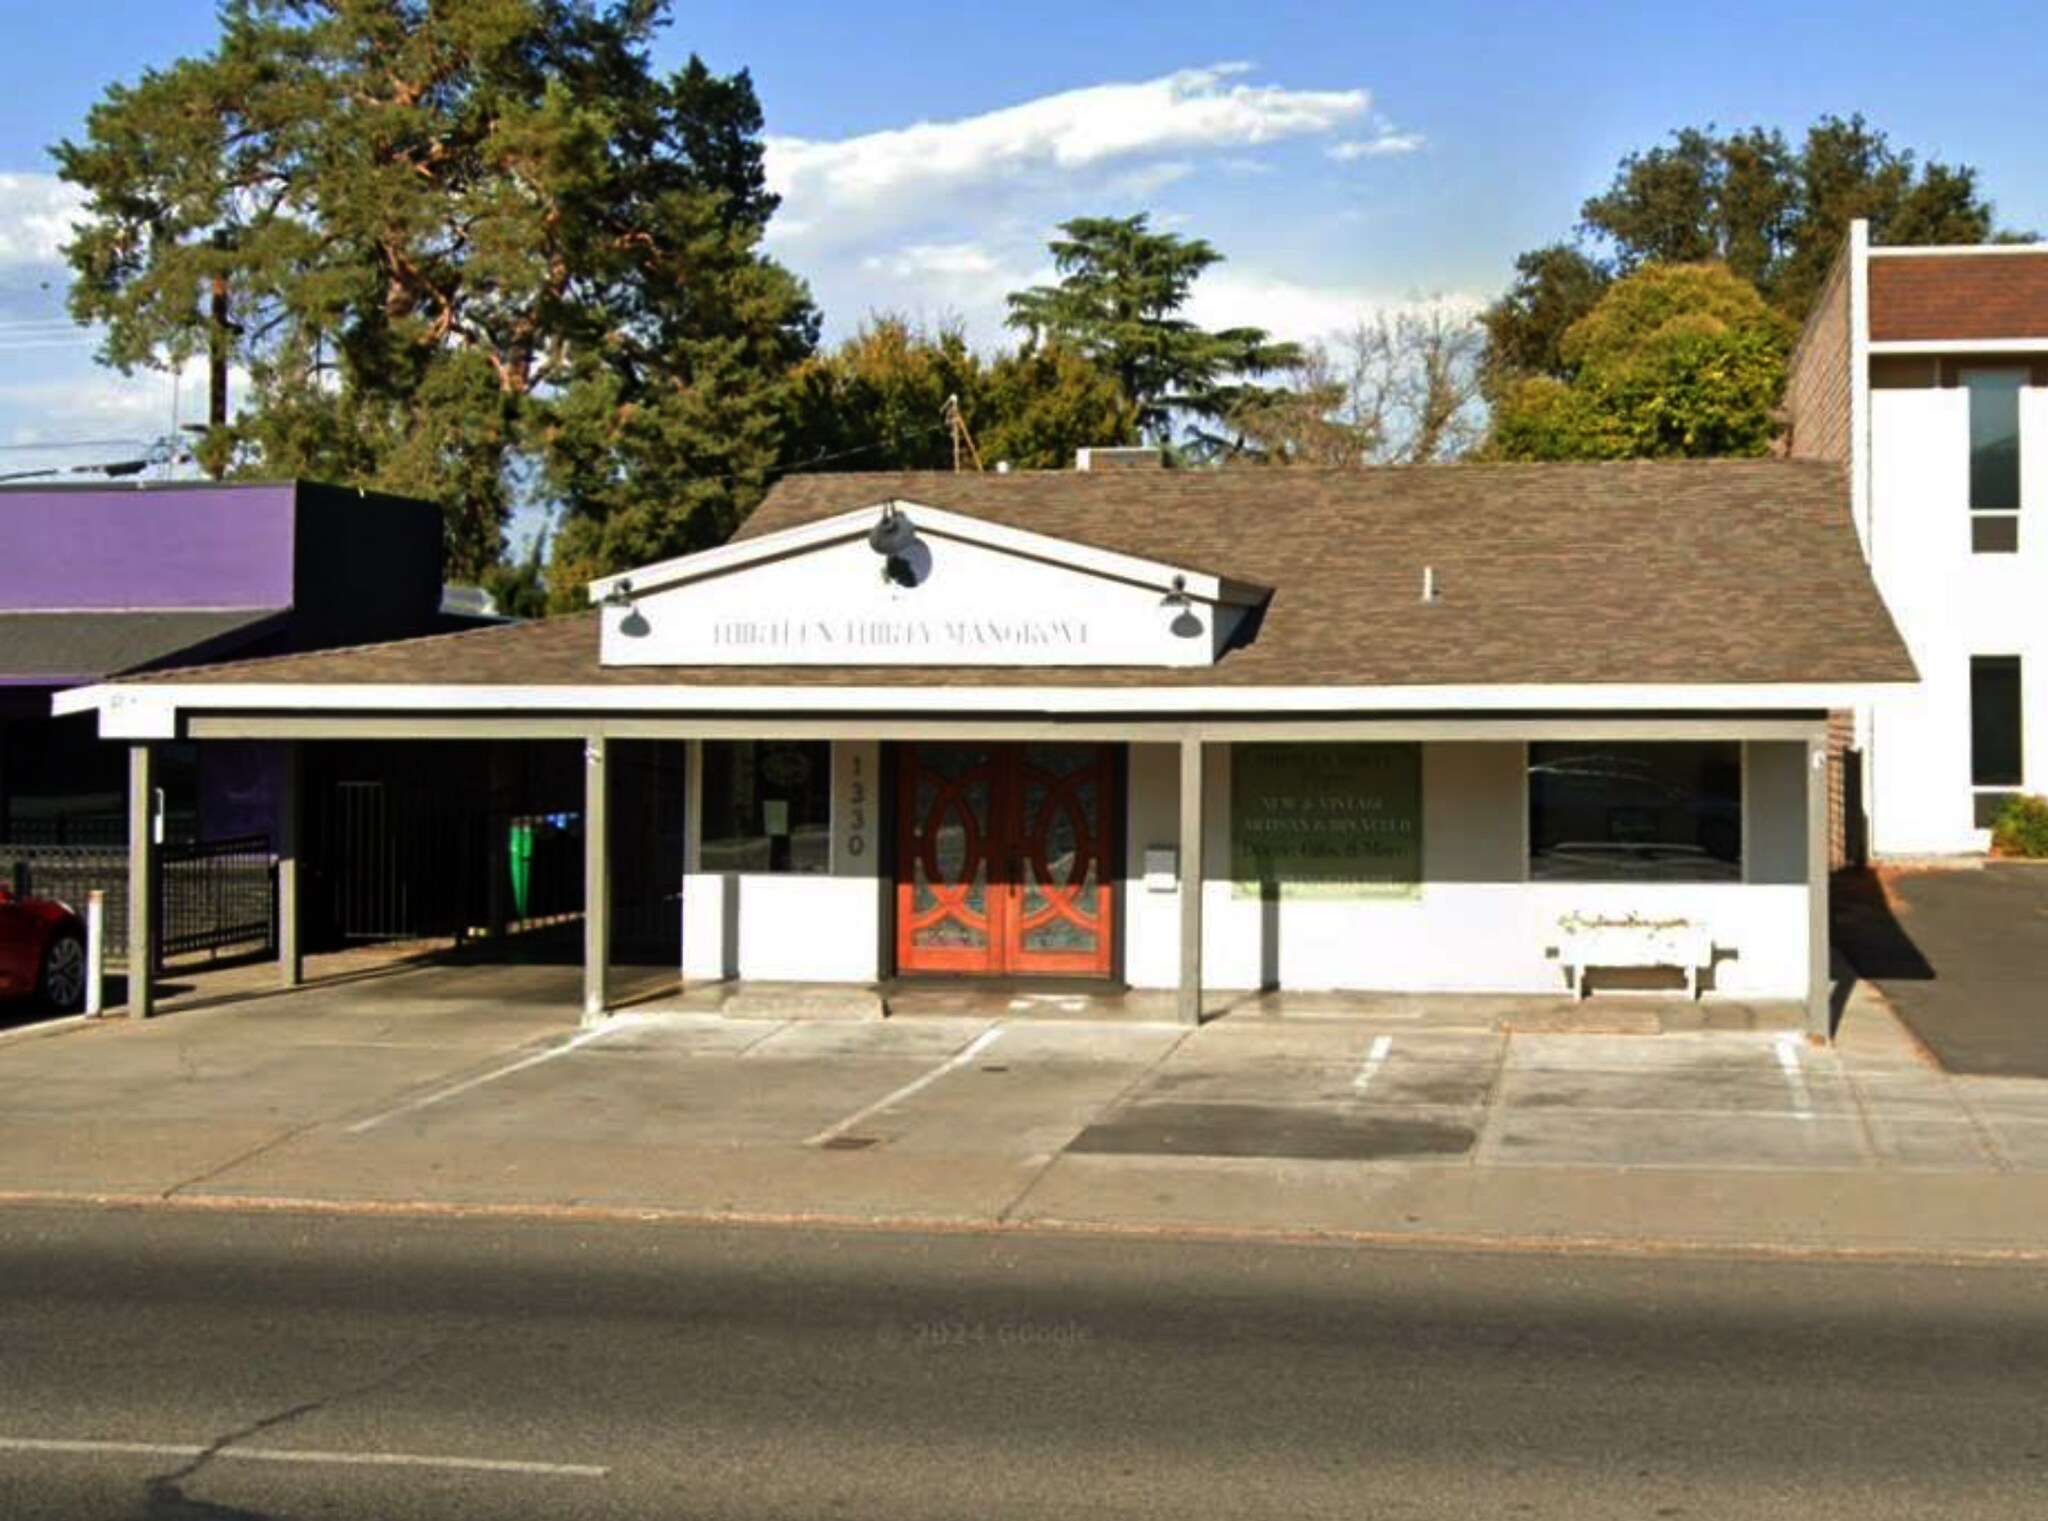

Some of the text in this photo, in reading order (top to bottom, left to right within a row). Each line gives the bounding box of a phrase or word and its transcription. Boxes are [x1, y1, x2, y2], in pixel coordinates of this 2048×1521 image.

[712, 621, 1090, 645] THIRTEEN THIRTY MANGROVE
[847, 755, 866, 857] 1330
